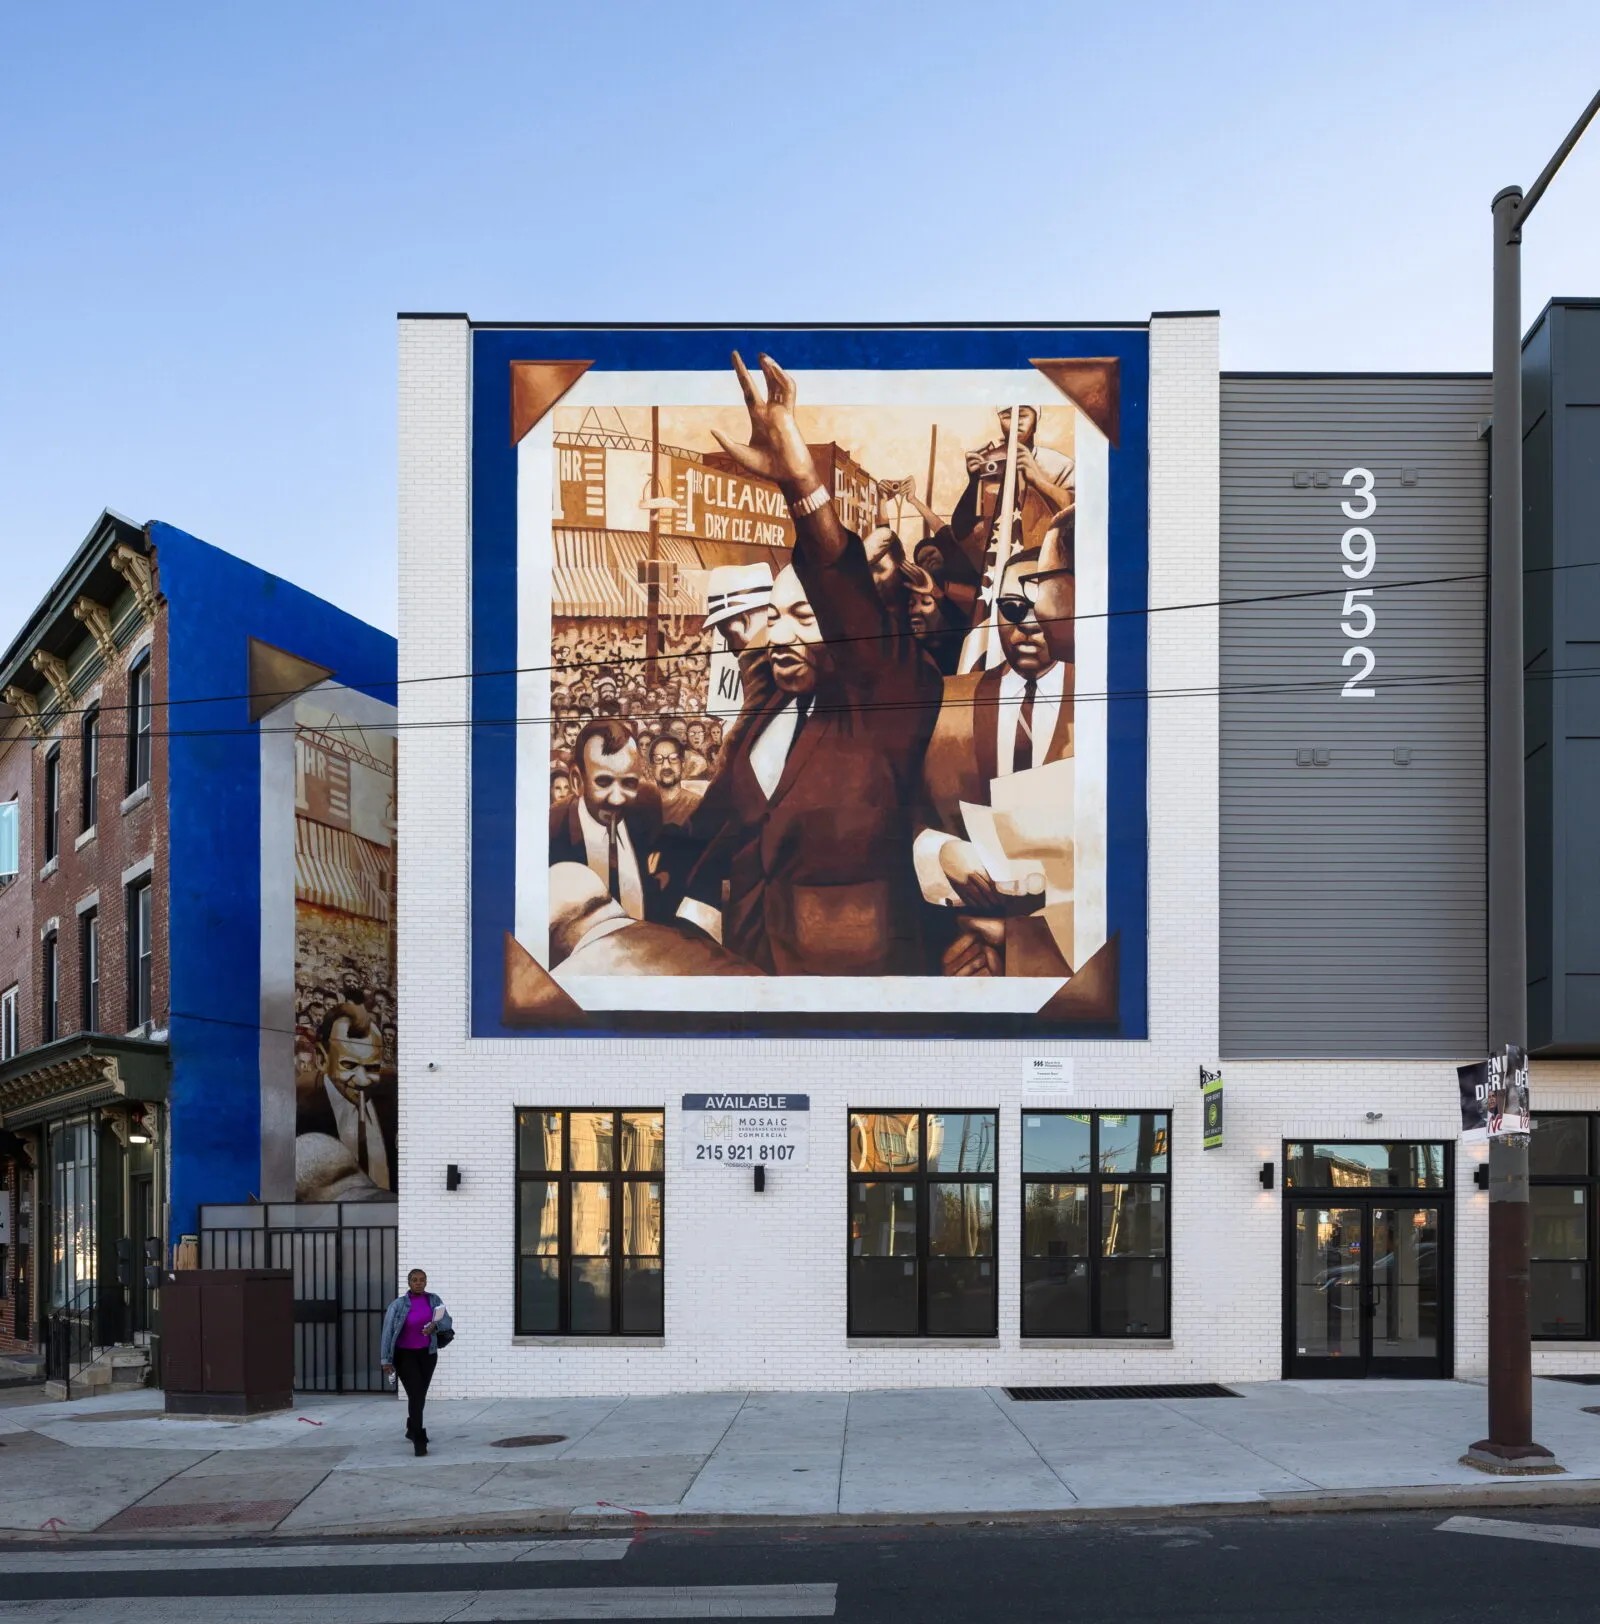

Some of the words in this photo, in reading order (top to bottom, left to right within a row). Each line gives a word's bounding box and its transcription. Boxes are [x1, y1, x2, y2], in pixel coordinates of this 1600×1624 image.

[560, 449, 582, 481] HR
[704, 473, 791, 519] CLEARVIE
[704, 512, 730, 540] DRY
[705, 1096, 787, 1109] AVAILABLE
[739, 1118, 787, 1126] MOSAIC
[696, 1145, 723, 1160] 215
[728, 1145, 753, 1160] 921
[760, 1145, 795, 1160] 8107
